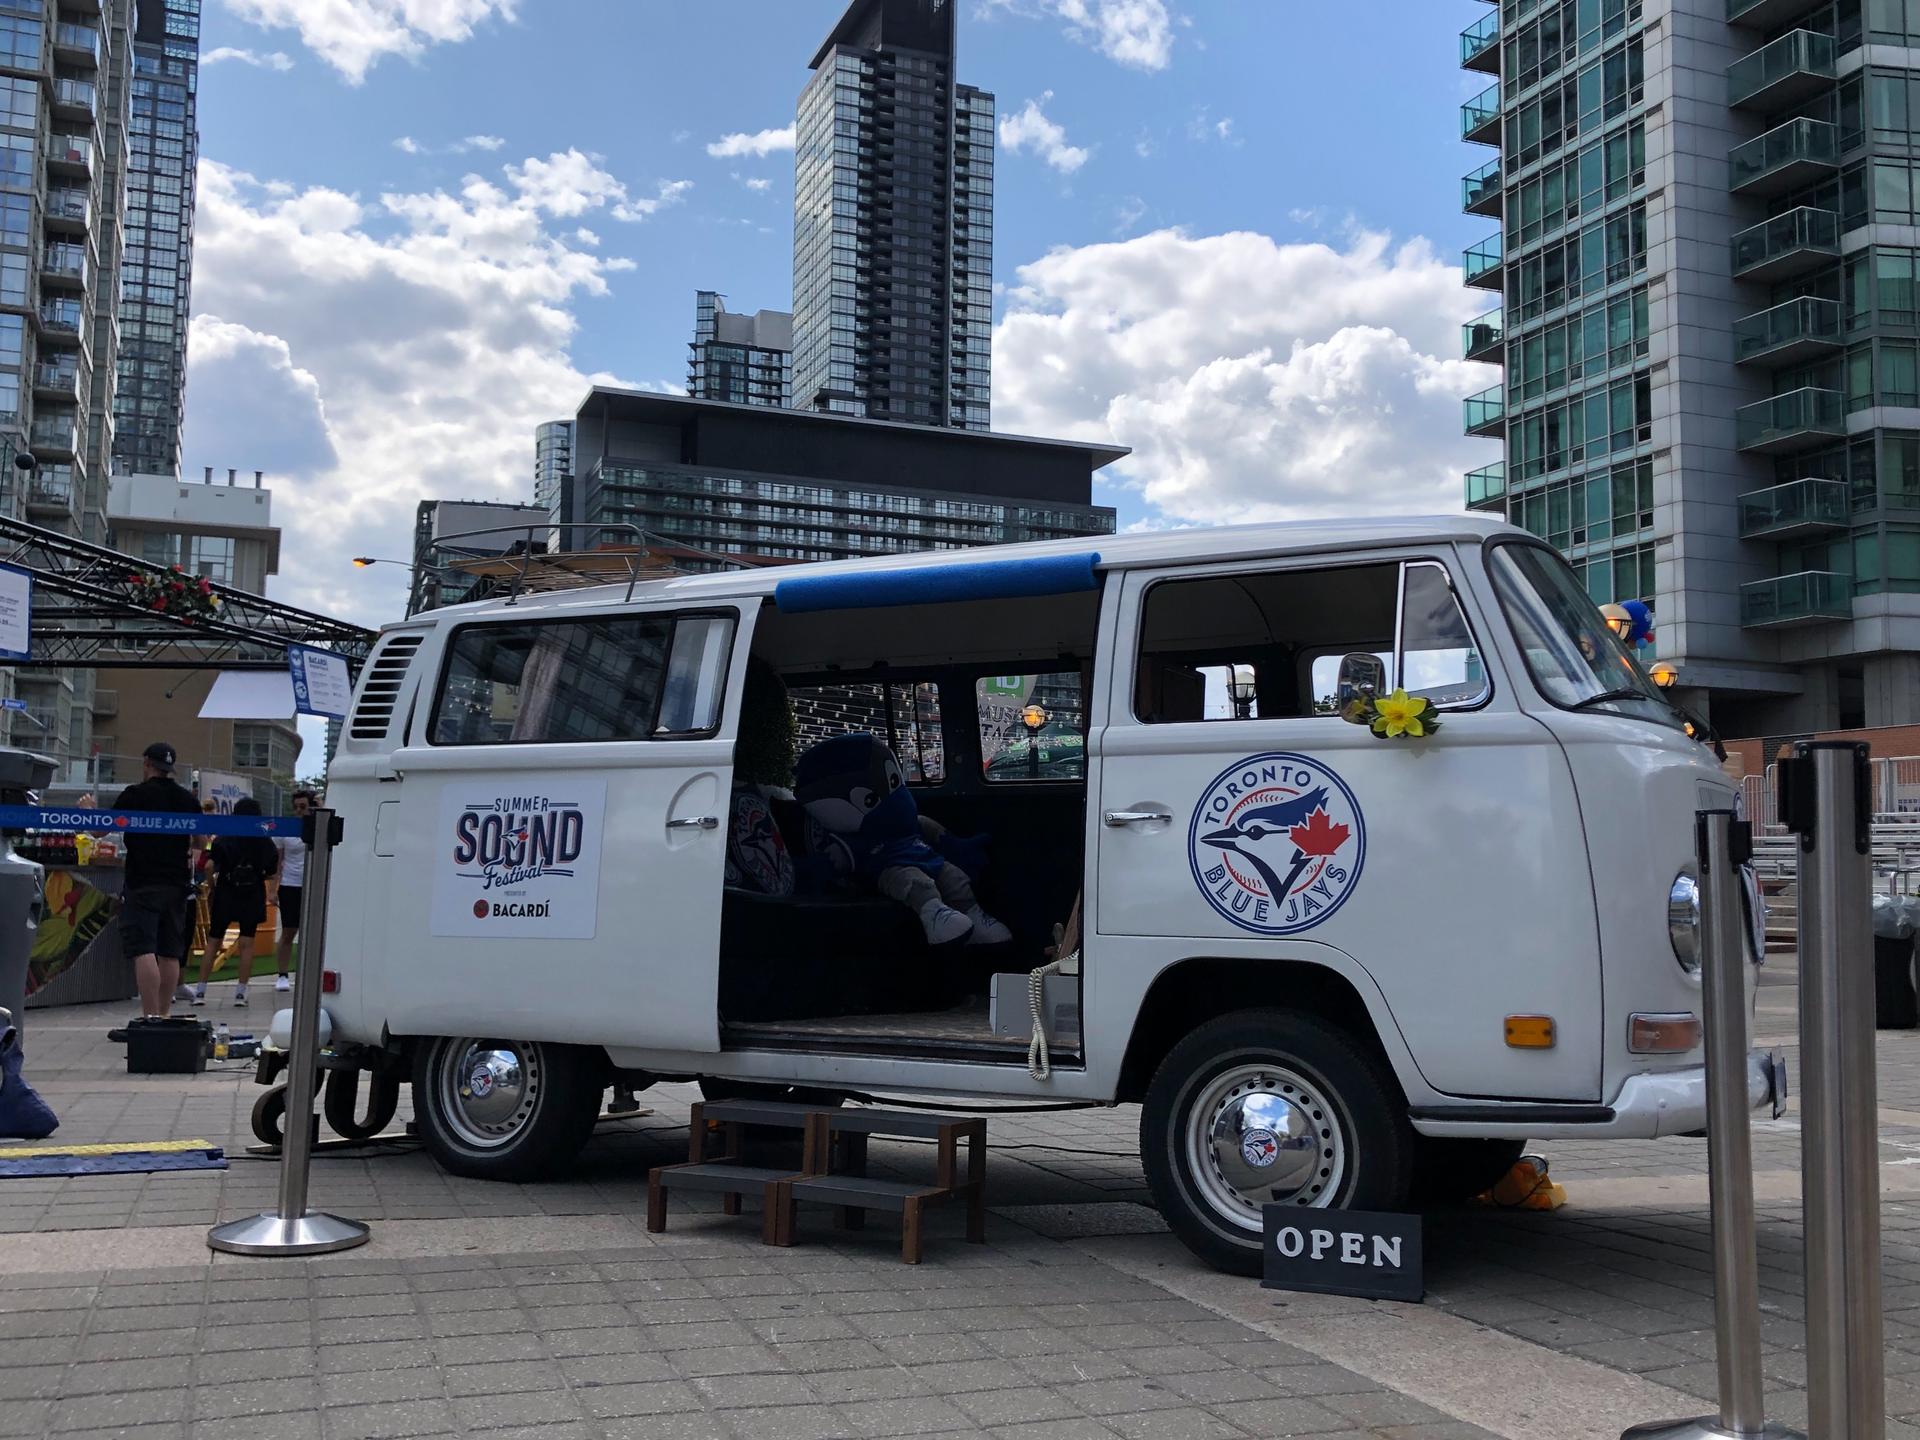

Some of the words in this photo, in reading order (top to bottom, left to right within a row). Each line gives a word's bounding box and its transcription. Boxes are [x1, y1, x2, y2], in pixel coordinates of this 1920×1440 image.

[494, 796, 549, 813] SUMMER
[1204, 765, 1311, 825] TORONTO
[40, 812, 113, 826] TORONTO
[130, 816, 162, 829] BLUE
[164, 818, 197, 830] JAYS
[454, 809, 584, 870] SOUND
[482, 858, 545, 890] Festival
[492, 899, 551, 918] BACARDÍ
[1204, 863, 1270, 923] BLUE
[1285, 863, 1347, 923] JAYS
[1276, 1226, 1402, 1268] OPEN
